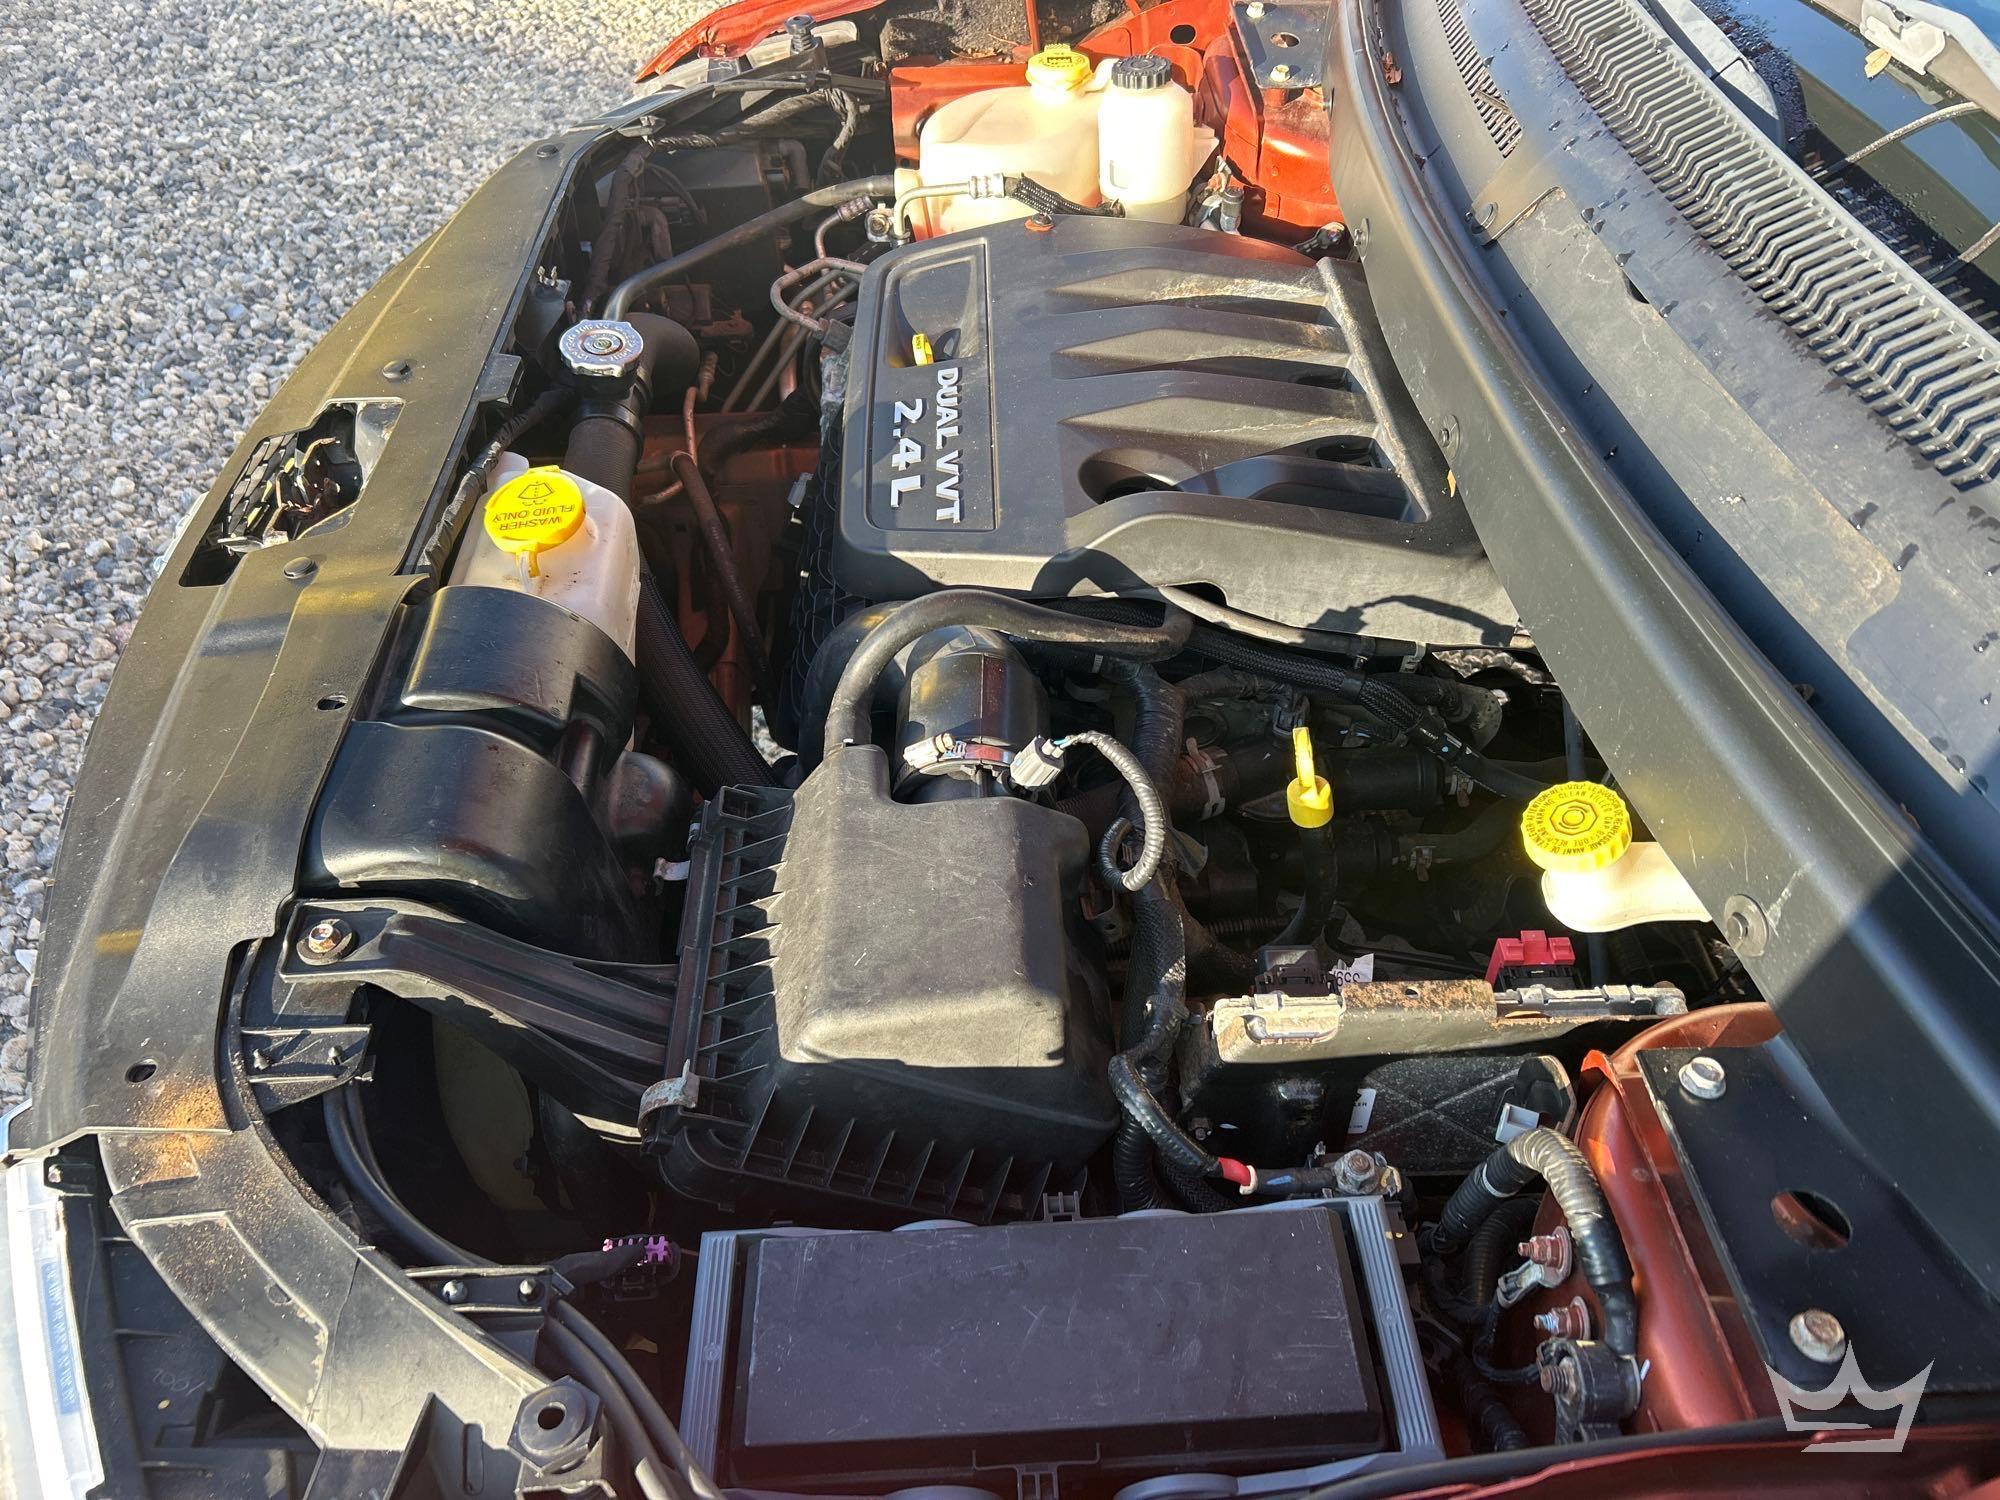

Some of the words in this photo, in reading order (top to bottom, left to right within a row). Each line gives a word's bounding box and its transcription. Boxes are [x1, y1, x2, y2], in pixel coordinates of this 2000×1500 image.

[936, 367, 961, 450] DUAL
[936, 450, 961, 524] VVT
[492, 510, 528, 523] ONLY
[532, 505, 576, 517] FLUID
[499, 516, 561, 531] WASHER
